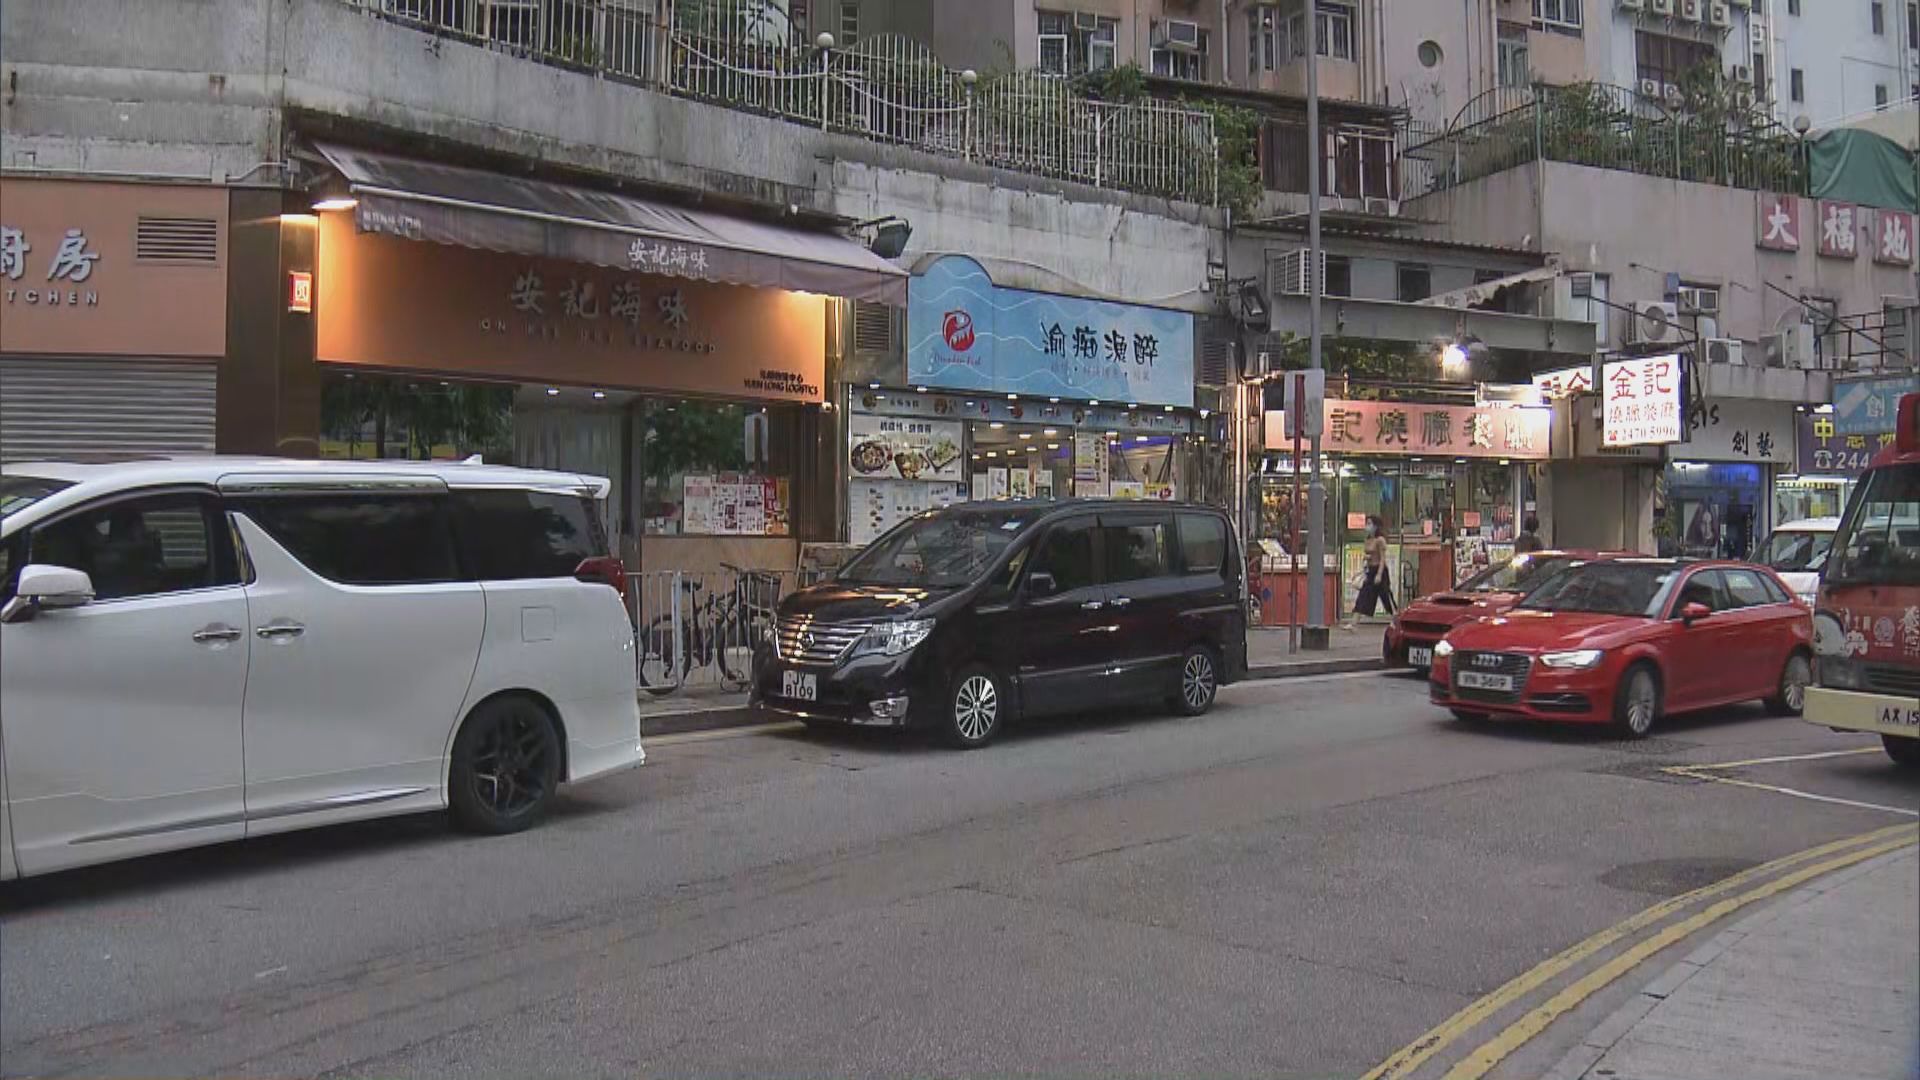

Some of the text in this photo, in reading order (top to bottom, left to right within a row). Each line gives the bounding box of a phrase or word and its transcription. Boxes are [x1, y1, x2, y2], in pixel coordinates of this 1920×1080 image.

[1763, 204, 1910, 261] 大福地
[628, 238, 709, 271] 安記海味
[510, 269, 690, 329] 安記海味
[1610, 362, 1672, 401] 金記
[1732, 430, 1775, 457] 創藝
